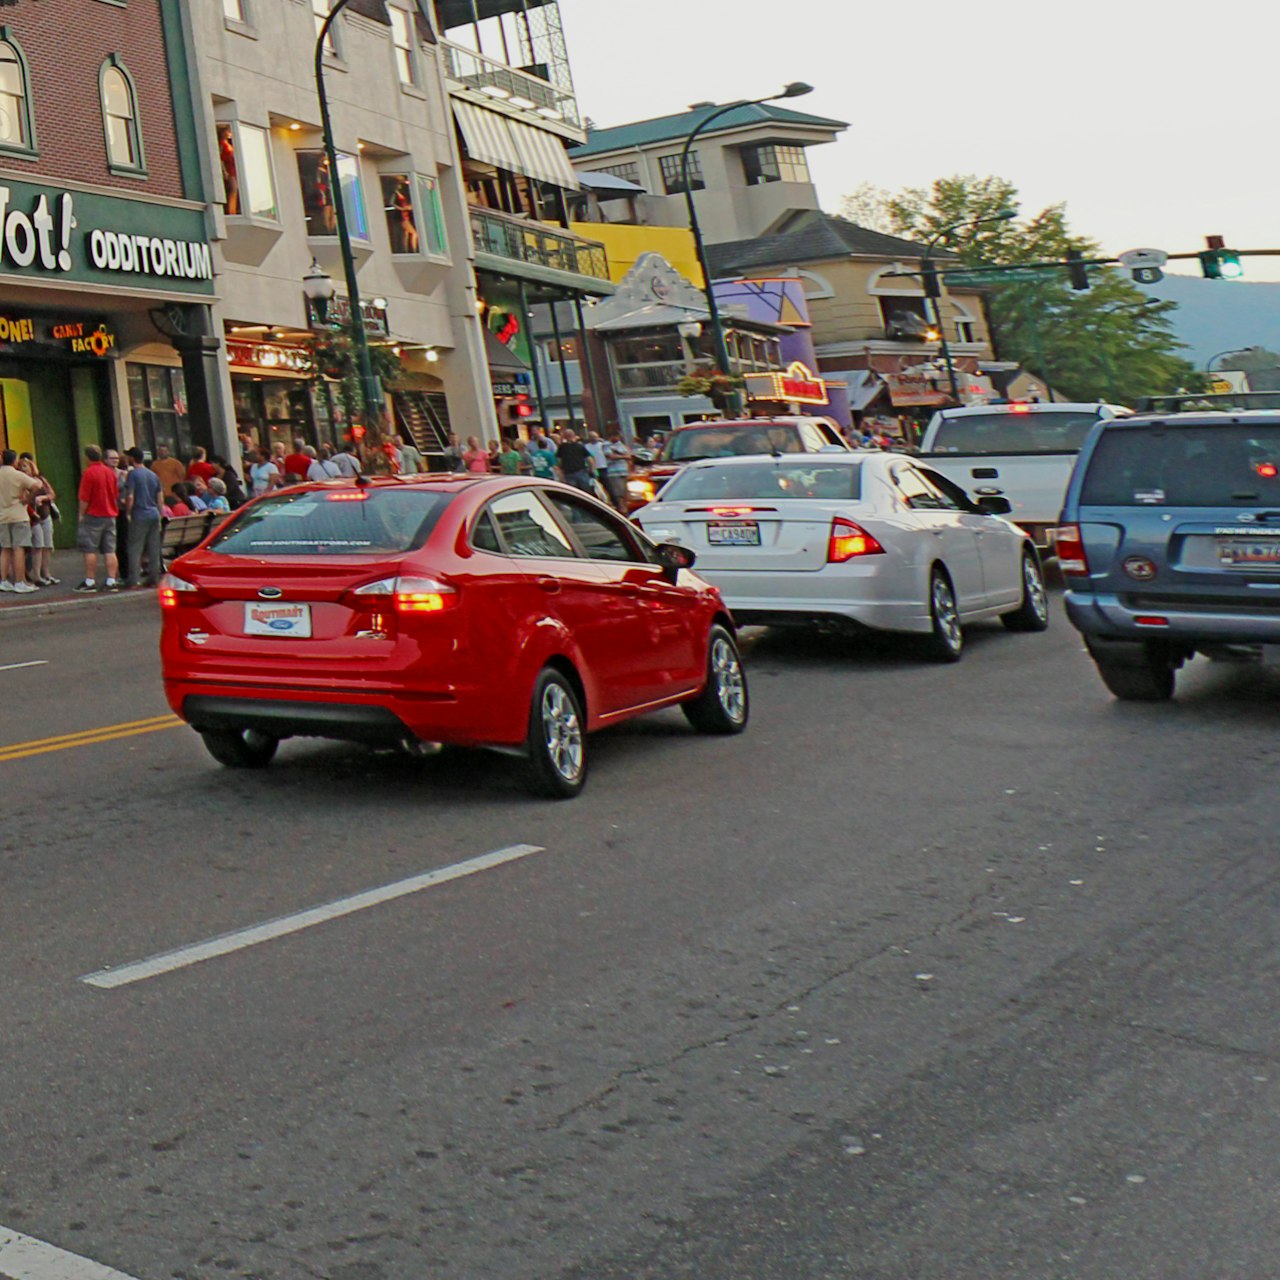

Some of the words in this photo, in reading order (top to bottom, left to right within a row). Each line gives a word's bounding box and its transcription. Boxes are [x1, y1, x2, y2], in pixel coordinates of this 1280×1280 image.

[89, 229, 214, 281] ODDITORIUM
[1141, 269, 1153, 280] 8
[52, 322, 84, 339] CANDY
[72, 329, 115, 356] FACTORY
